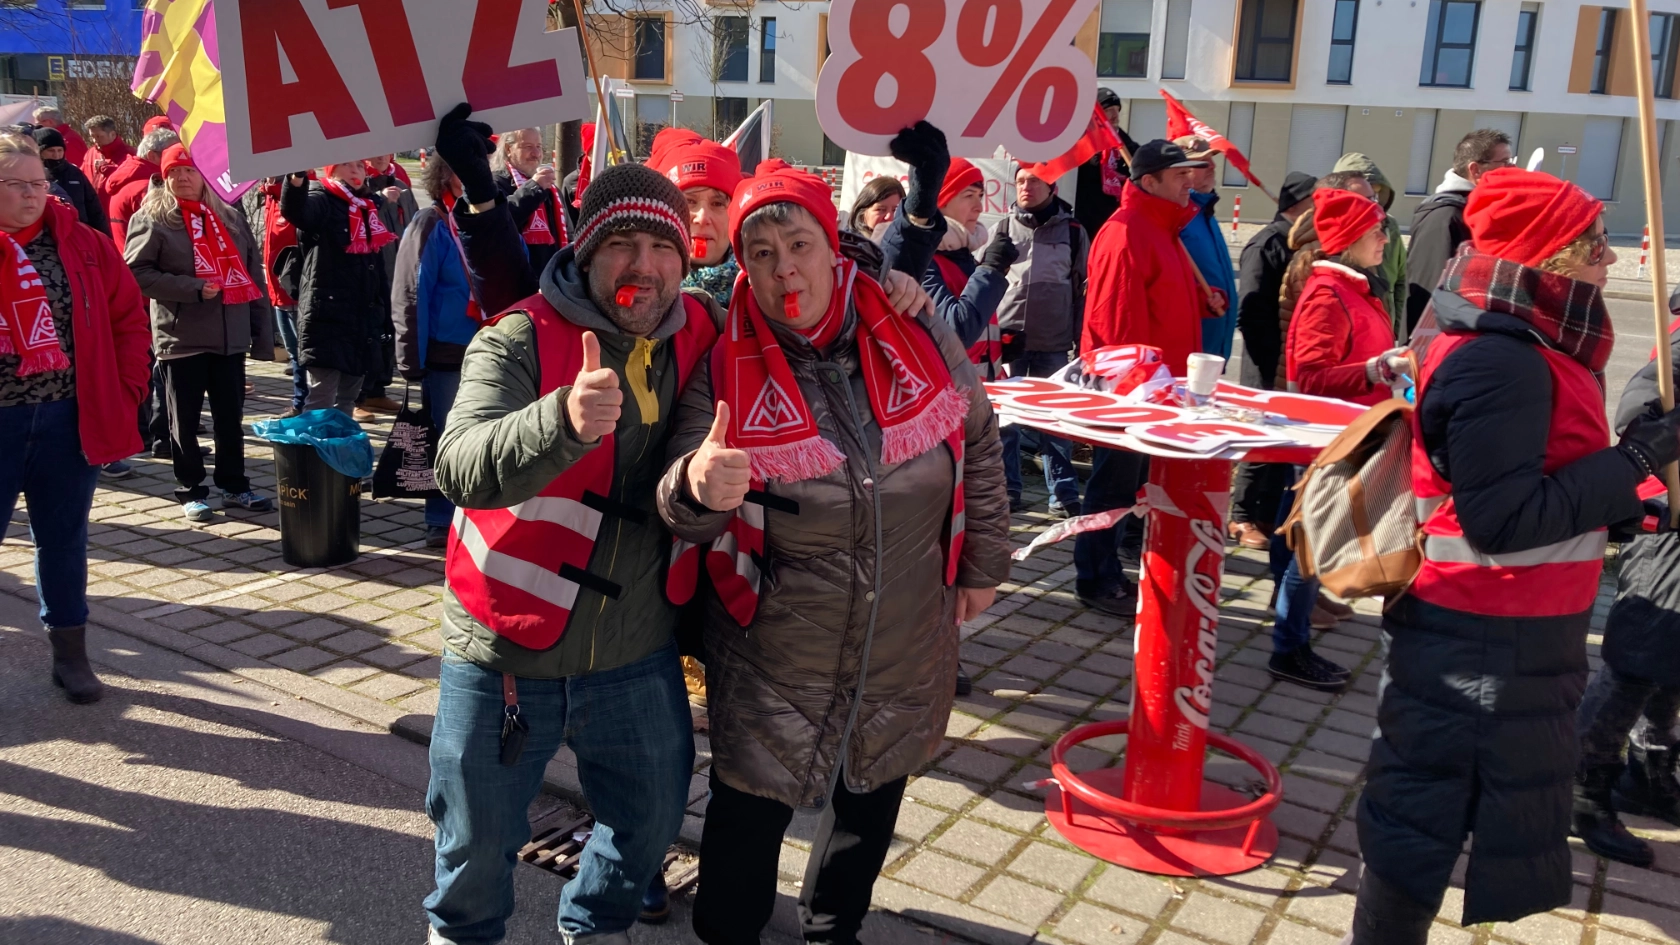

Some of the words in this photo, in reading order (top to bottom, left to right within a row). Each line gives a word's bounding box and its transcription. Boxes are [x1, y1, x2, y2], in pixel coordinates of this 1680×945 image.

[837, 0, 1078, 143] 8%
[682, 162, 706, 172] WIR
[757, 181, 784, 190] WIR
[1174, 518, 1225, 730] Coca-Cl
[1172, 721, 1192, 752] Trink
